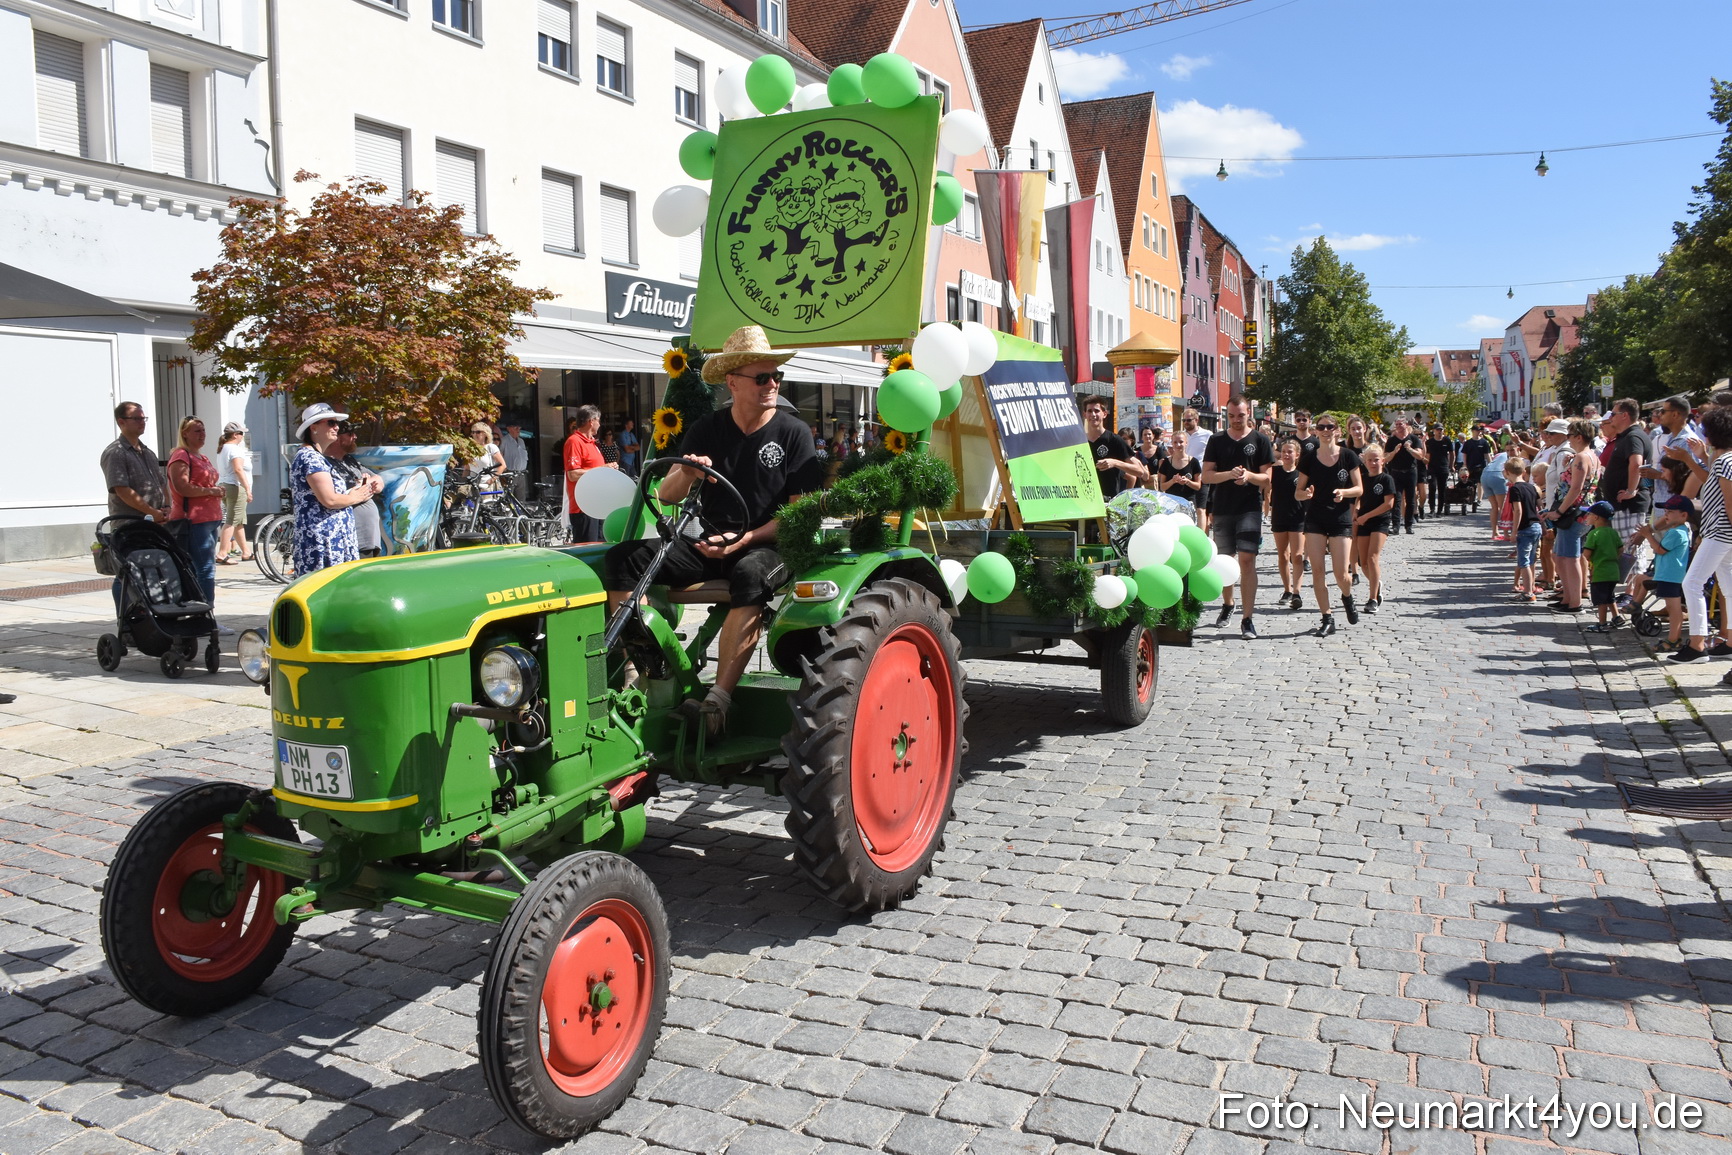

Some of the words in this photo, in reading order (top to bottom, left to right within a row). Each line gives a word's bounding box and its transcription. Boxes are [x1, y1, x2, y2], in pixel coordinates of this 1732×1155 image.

[614, 281, 697, 328] frühauf
[744, 279, 779, 316] Roll-Club
[794, 302, 825, 324] DJK
[835, 258, 890, 309] Neumarkt
[1245, 322, 1257, 385] HOTEL
[995, 399, 1040, 436] FUNNY
[1037, 397, 1079, 429] ROLLERS
[486, 581, 555, 605] DEUTZ
[273, 709, 345, 730] DEUTZ
[288, 745, 311, 769] NM
[291, 768, 313, 792] PH
[315, 772, 340, 795] 13
